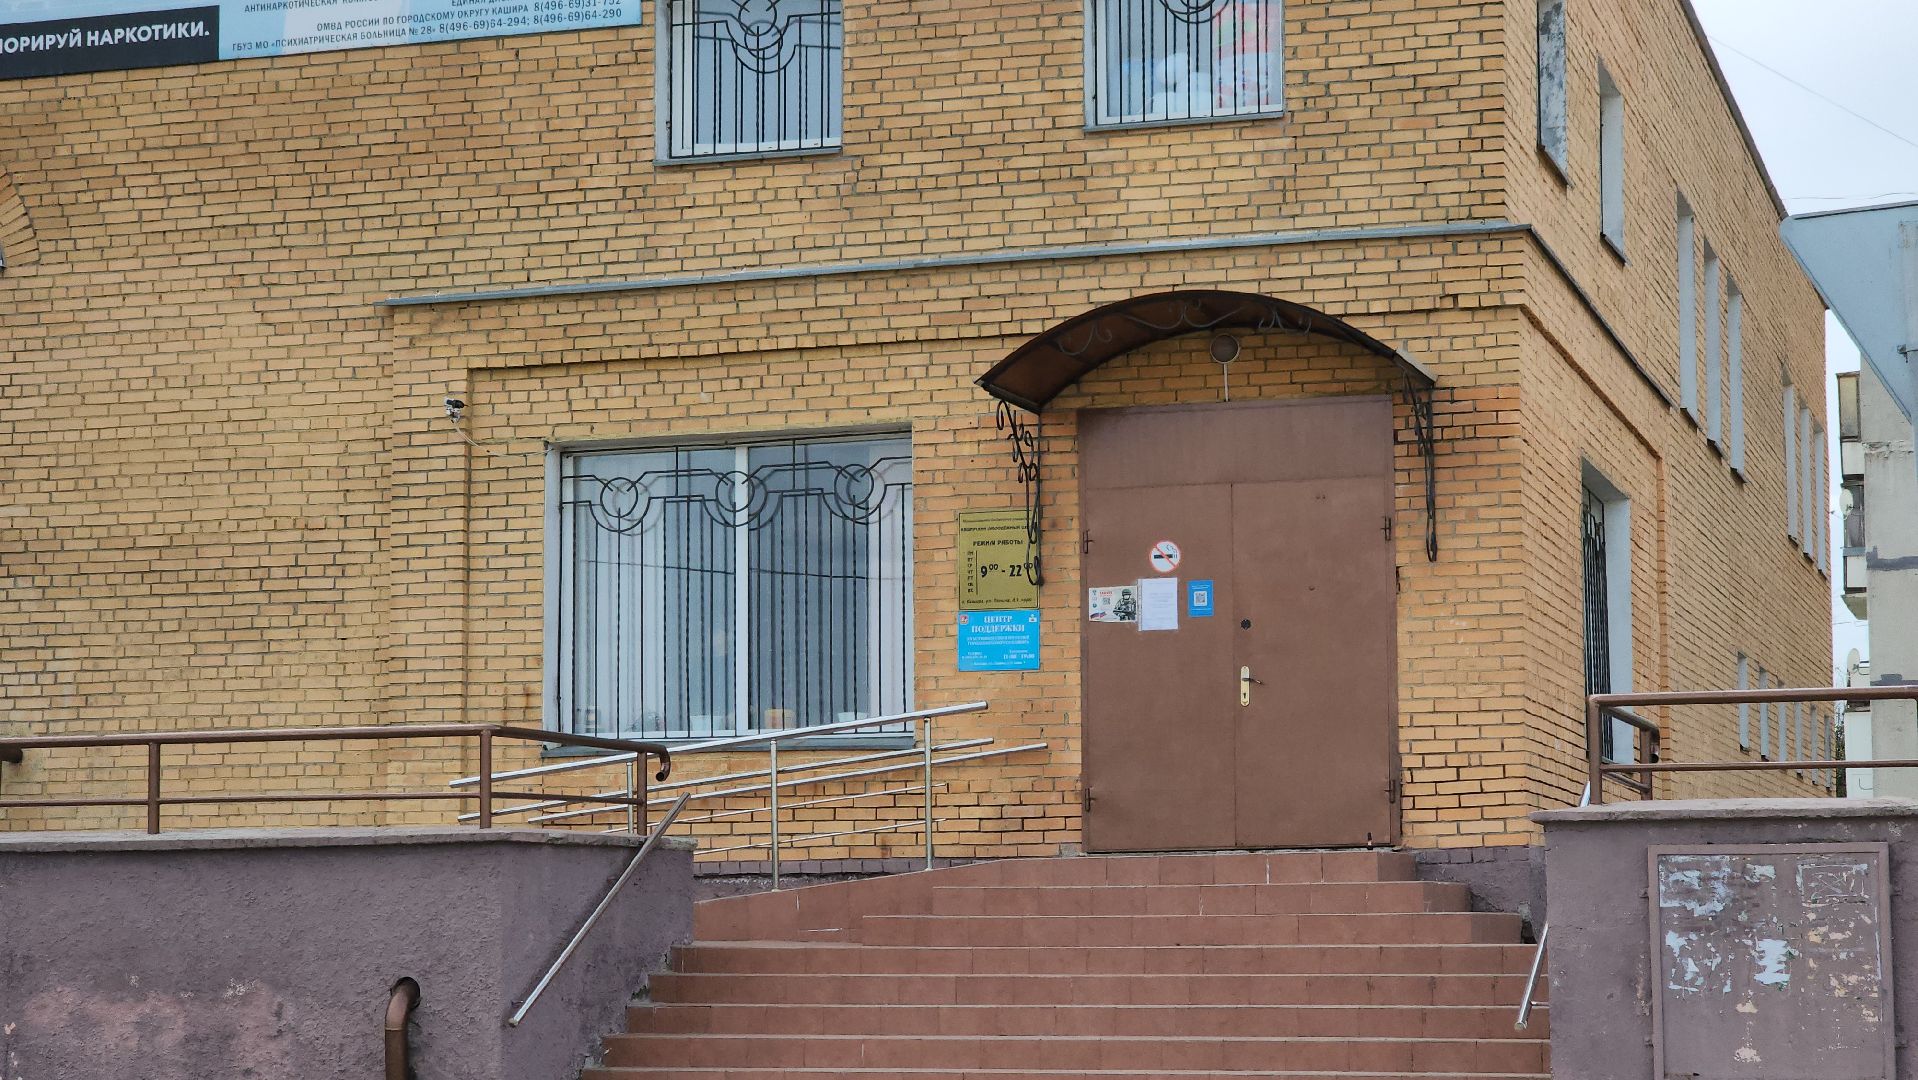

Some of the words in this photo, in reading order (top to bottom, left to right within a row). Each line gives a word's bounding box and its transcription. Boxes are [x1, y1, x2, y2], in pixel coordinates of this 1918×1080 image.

[316, 23, 342, 32] ОМВД
[345, 18, 380, 29] РОССИИ
[383, 16, 395, 25] ПО
[397, 12, 455, 25] ГОРОДСКОМУ
[457, 8, 489, 19] ОКРУГУ
[492, 5, 529, 16] КАШИРА
[0, 29, 82, 54] ОРИРУЙ
[86, 21, 210, 47] НАРКОТИКИ.
[232, 42, 253, 51] ГБУЗ
[255, 40, 269, 50] МО
[360, 29, 406, 40] БОЛЬНИЦА
[971, 624, 1025, 633] ПОДДЕРЖКИ
[984, 615, 1012, 623] ЦЕНТР
